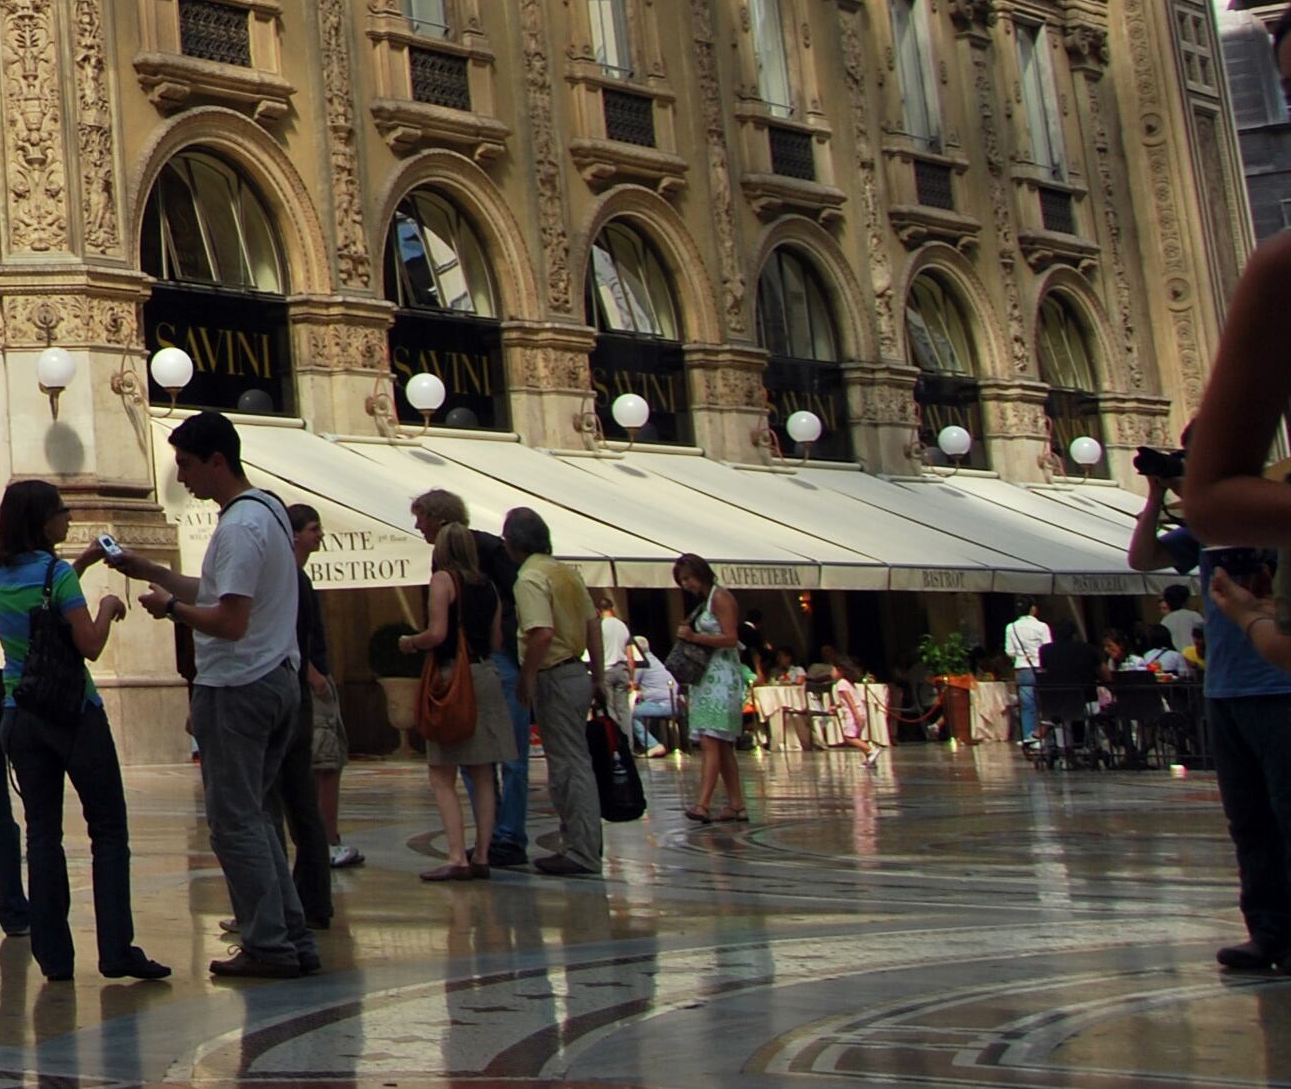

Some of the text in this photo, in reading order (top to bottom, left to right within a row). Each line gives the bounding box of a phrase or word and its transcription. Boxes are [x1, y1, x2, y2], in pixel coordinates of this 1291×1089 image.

[310, 558, 411, 582] BISTROT
[721, 566, 801, 586] CAFFETTERIA
[922, 570, 966, 589] BISTROT
